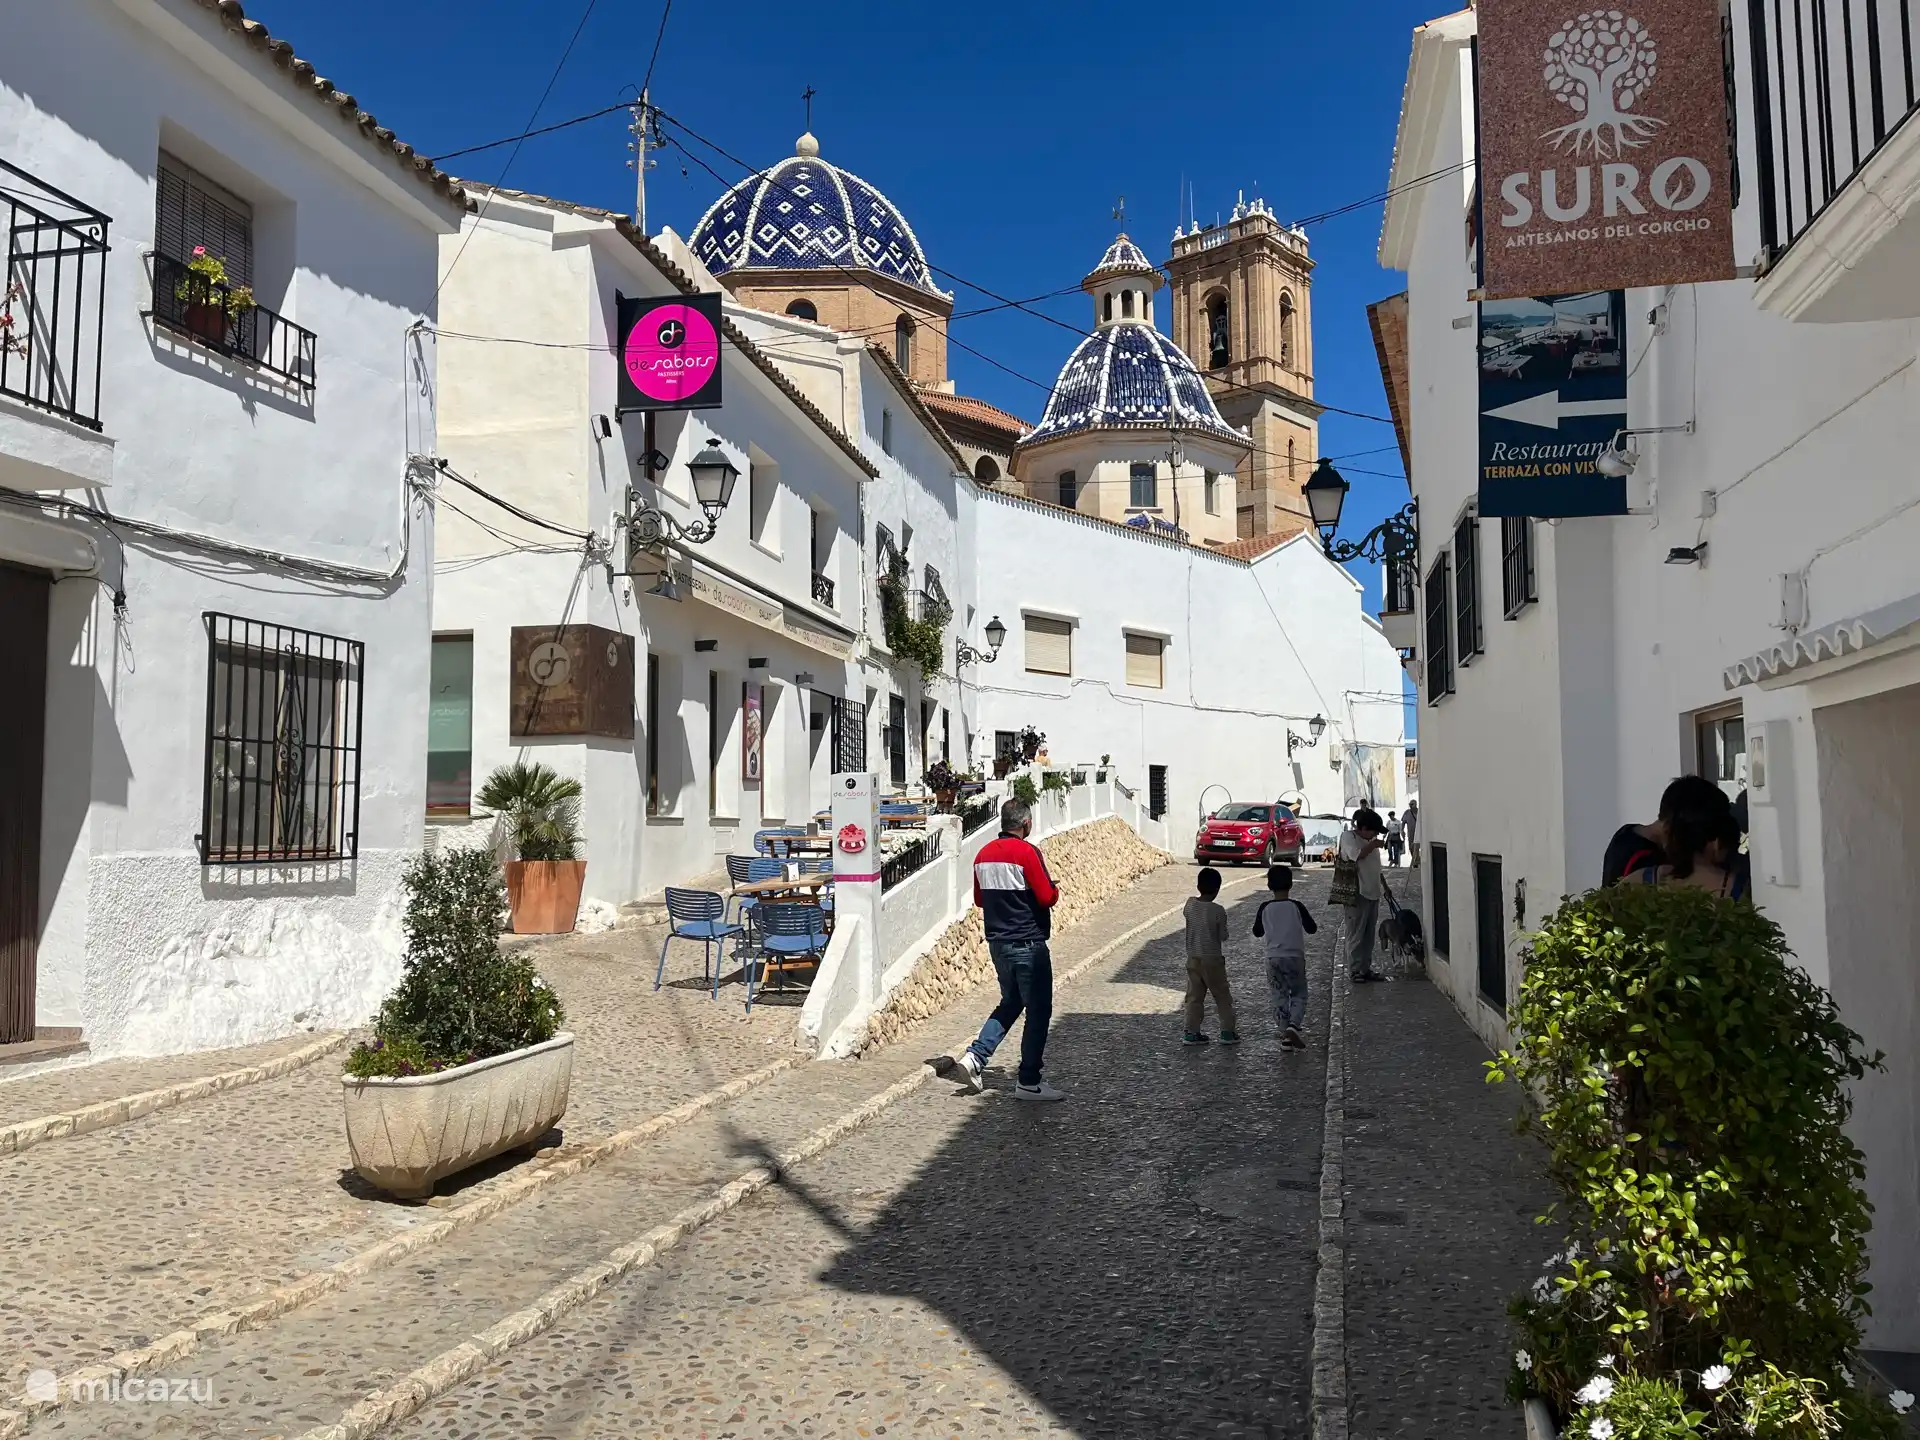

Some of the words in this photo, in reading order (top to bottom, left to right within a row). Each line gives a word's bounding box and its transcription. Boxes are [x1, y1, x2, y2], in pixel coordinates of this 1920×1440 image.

[1500, 156, 1711, 228] SURO
[1505, 227, 1599, 248] ARTESANOS
[1604, 225, 1633, 239] DEL
[1638, 218, 1711, 235] CORCHO
[1483, 463, 1541, 479] TERRAZA
[1543, 462, 1571, 476] CON
[1574, 460, 1600, 474] VIS
